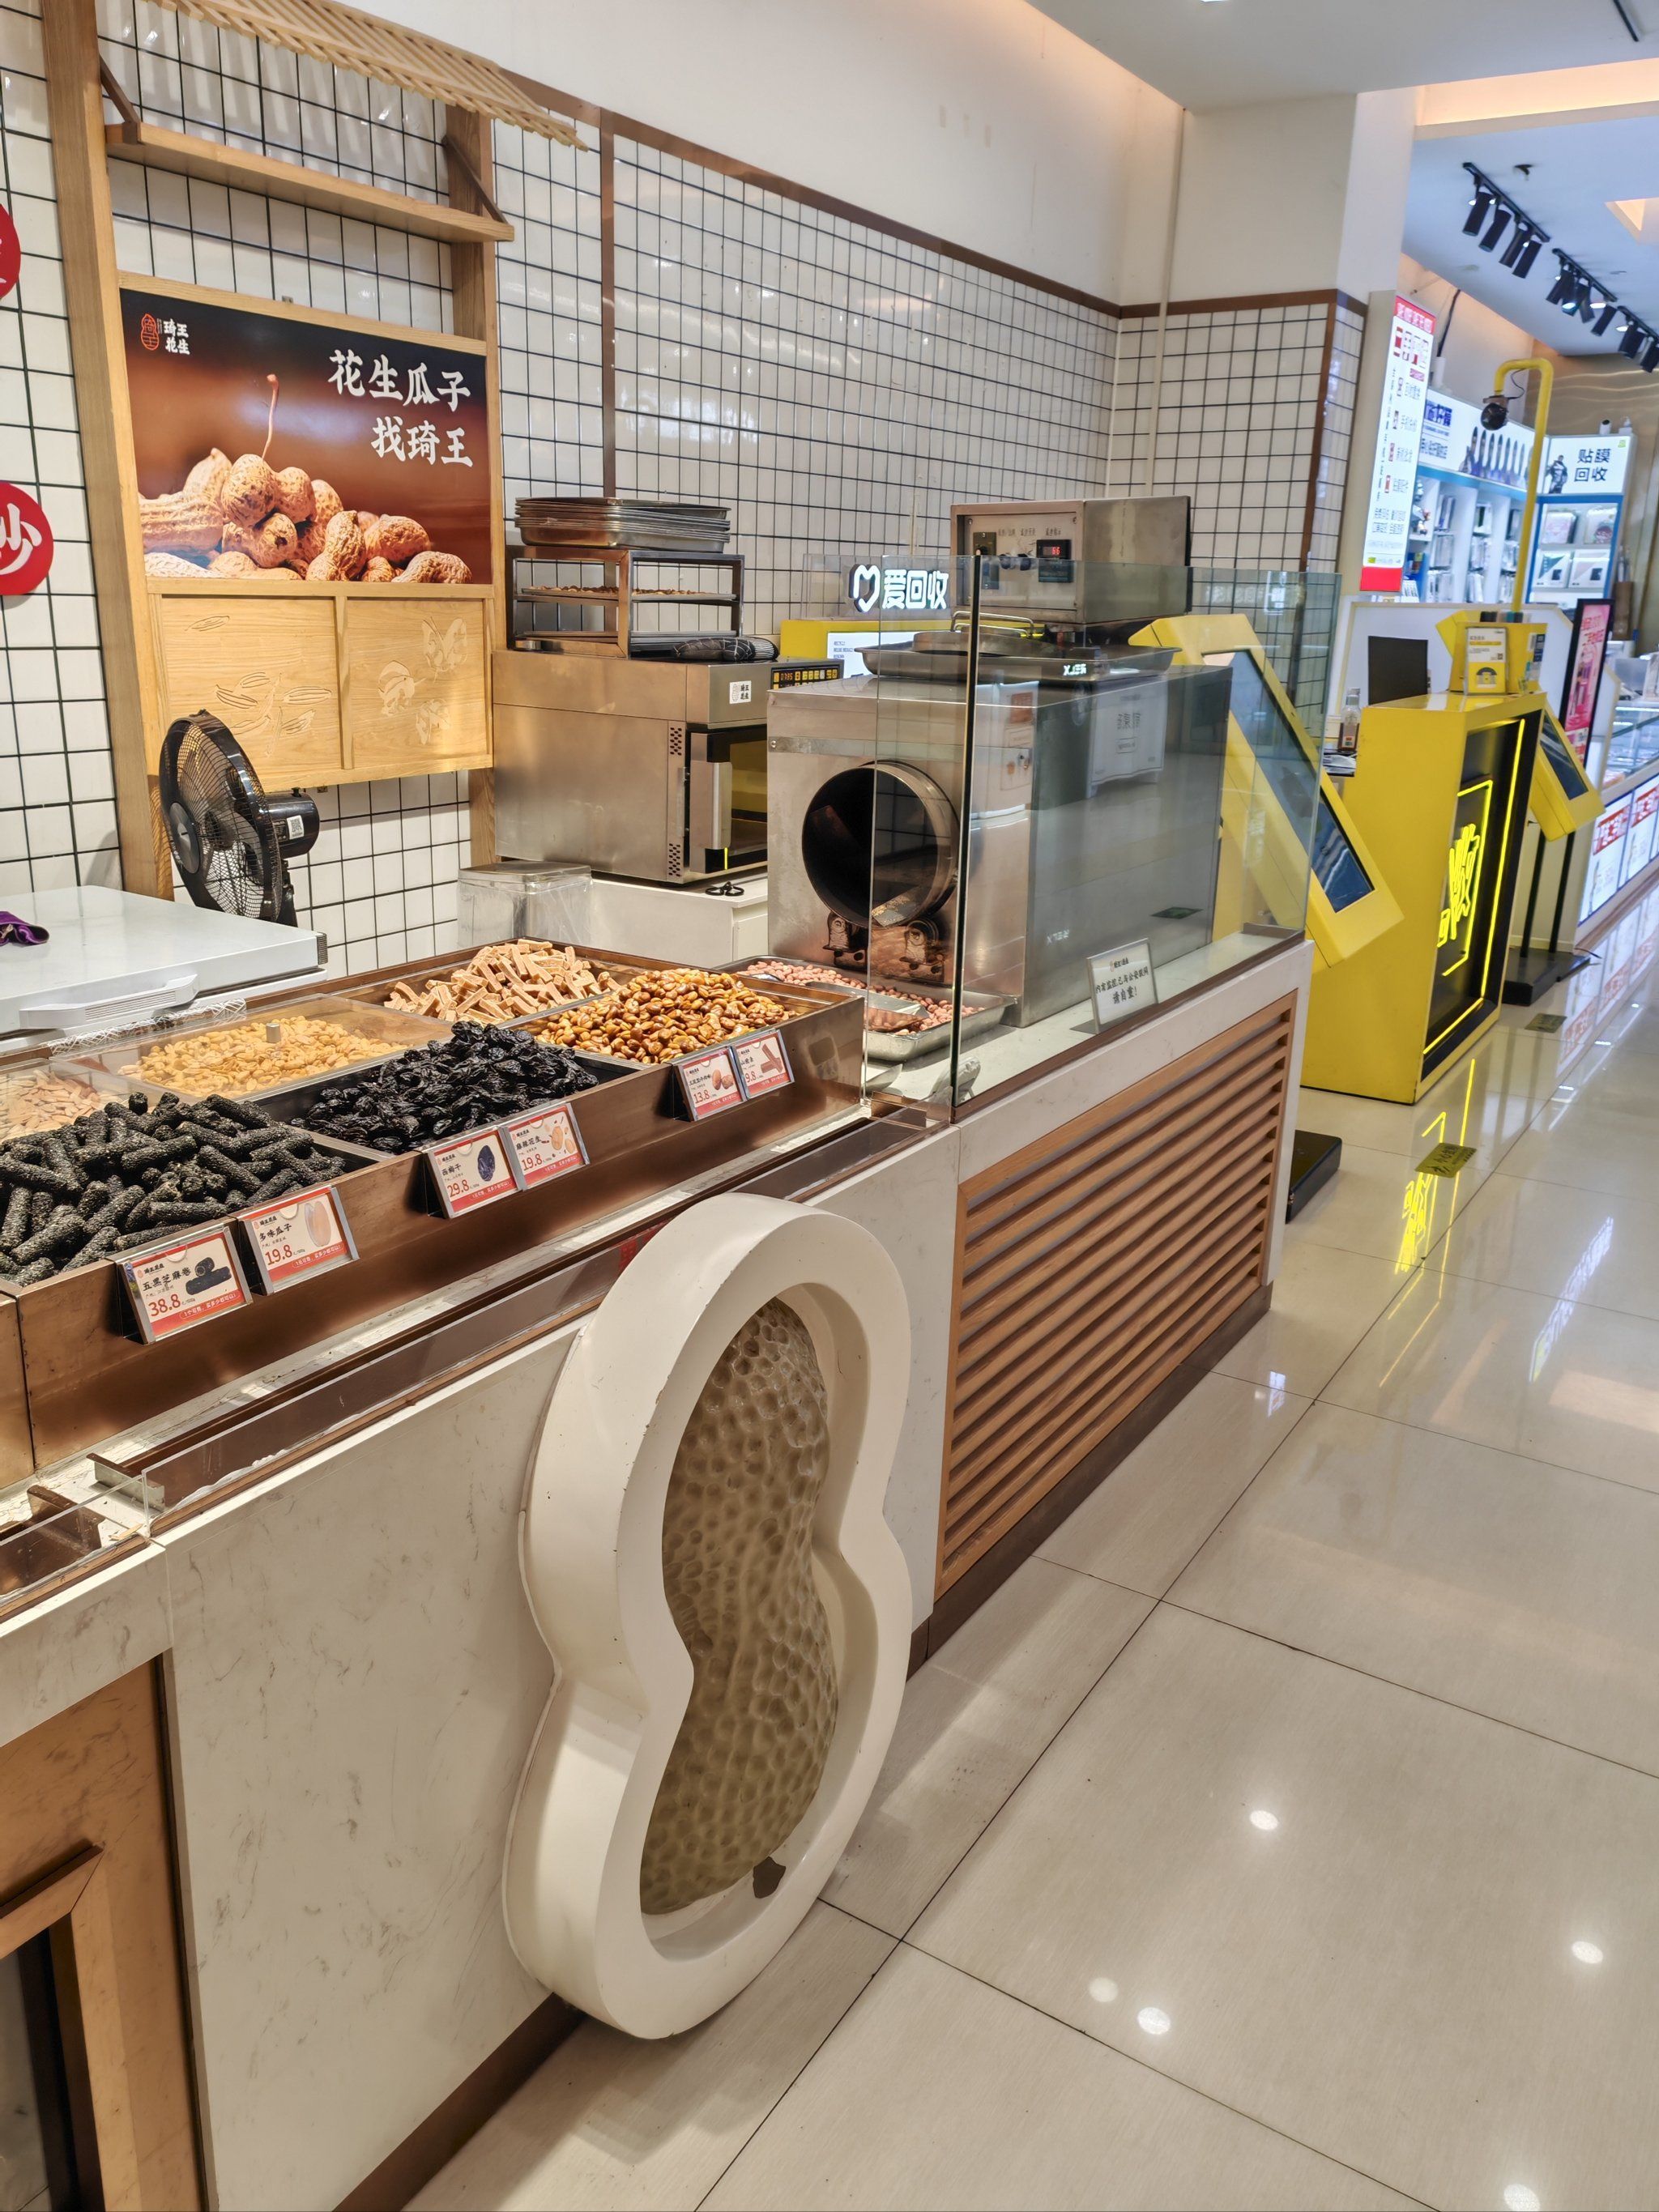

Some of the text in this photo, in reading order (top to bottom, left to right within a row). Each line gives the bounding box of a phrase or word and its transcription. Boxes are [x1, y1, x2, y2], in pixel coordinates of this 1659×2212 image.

[163, 318, 189, 338] 琦王
[165, 337, 190, 355] 花生
[328, 349, 471, 412] 花生瓜子
[370, 416, 473, 467] 找琦王
[1577, 448, 1610, 462] 贴膜
[1574, 467, 1608, 482] 回收
[882, 569, 949, 609] 爱回收
[745, 1071, 757, 1083] 9.8
[693, 1089, 710, 1103] 13.8
[441, 1163, 462, 1176] 西梅干
[522, 1153, 543, 1170] 19.8
[447, 1179, 469, 1197] 29.8
[259, 1223, 292, 1242] 多味瓜子
[265, 1244, 292, 1265] 19.8
[143, 1268, 191, 1291] 五黑芝麻卷
[148, 1294, 181, 1316] 38.8
